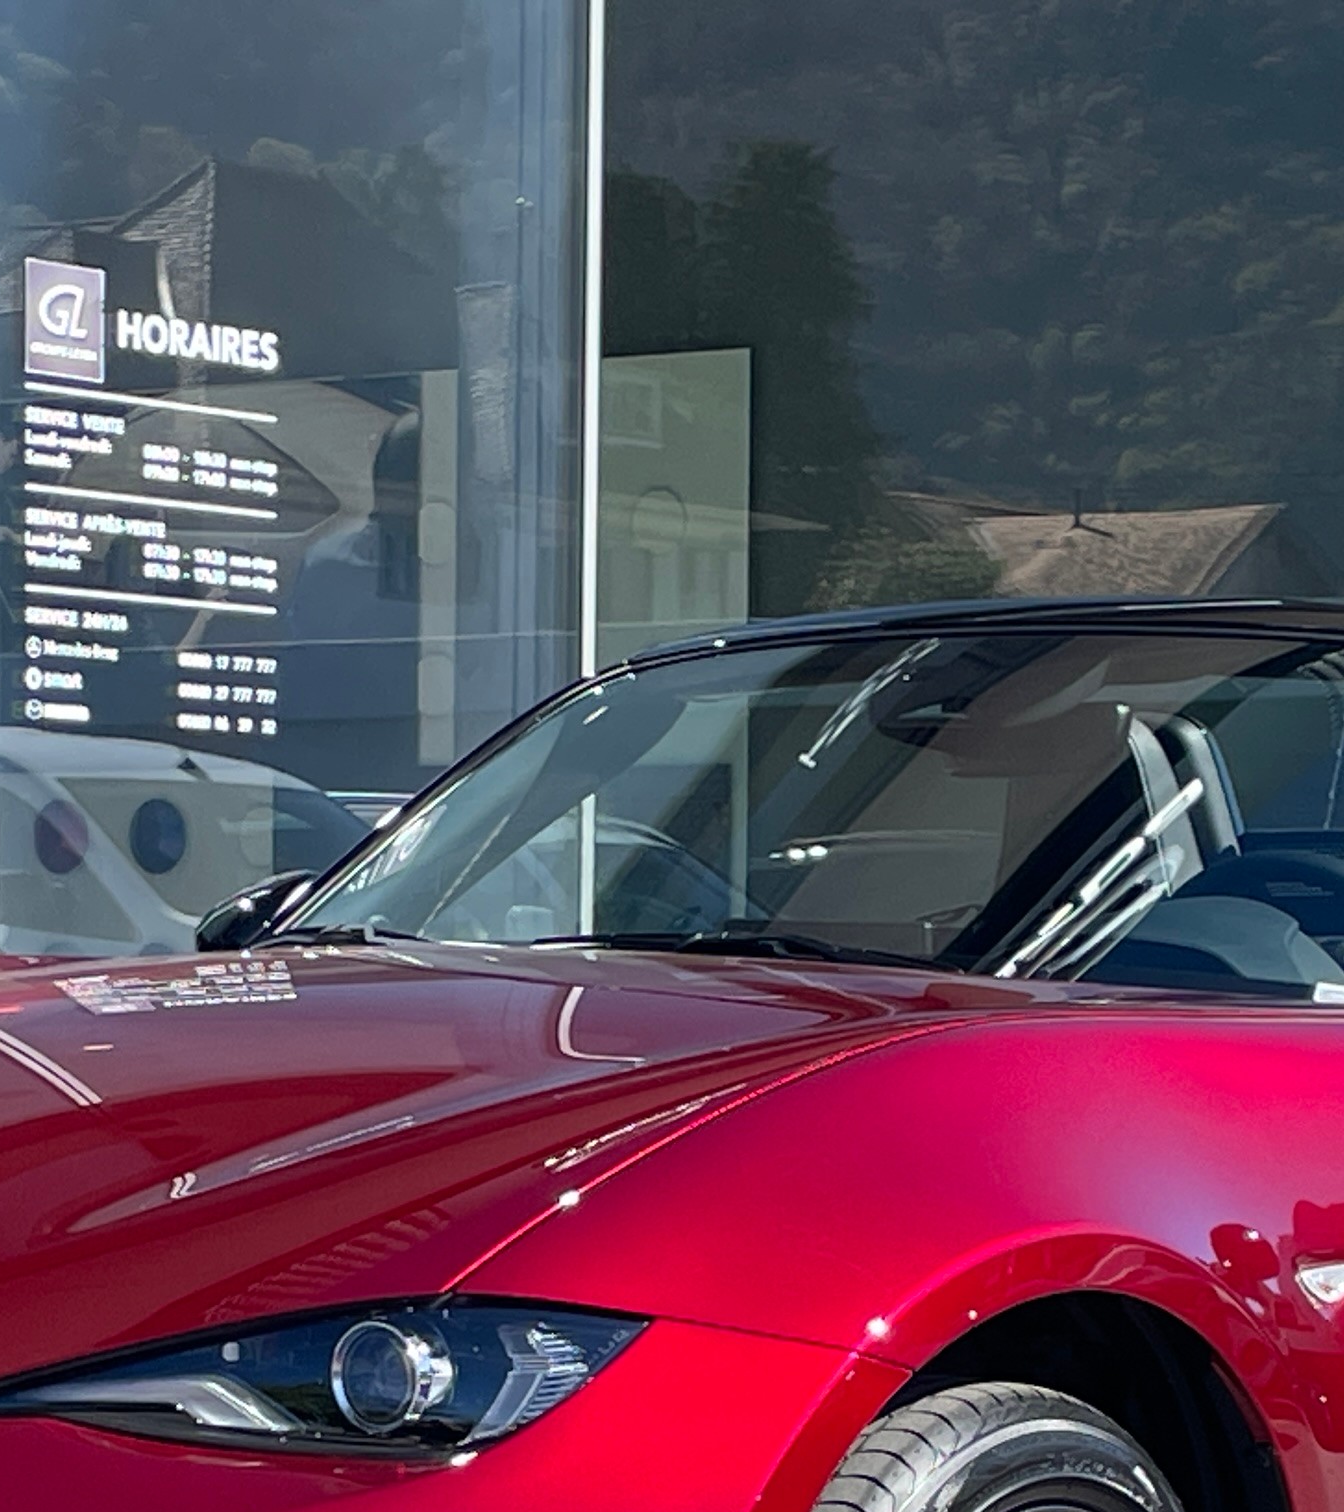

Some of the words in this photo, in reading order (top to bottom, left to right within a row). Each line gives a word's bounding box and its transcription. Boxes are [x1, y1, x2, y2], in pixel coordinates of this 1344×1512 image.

[117, 308, 279, 370] HORAIRES
[25, 406, 78, 428] SERVICE
[26, 508, 78, 529] SERVICE
[25, 607, 78, 627] SERVICE
